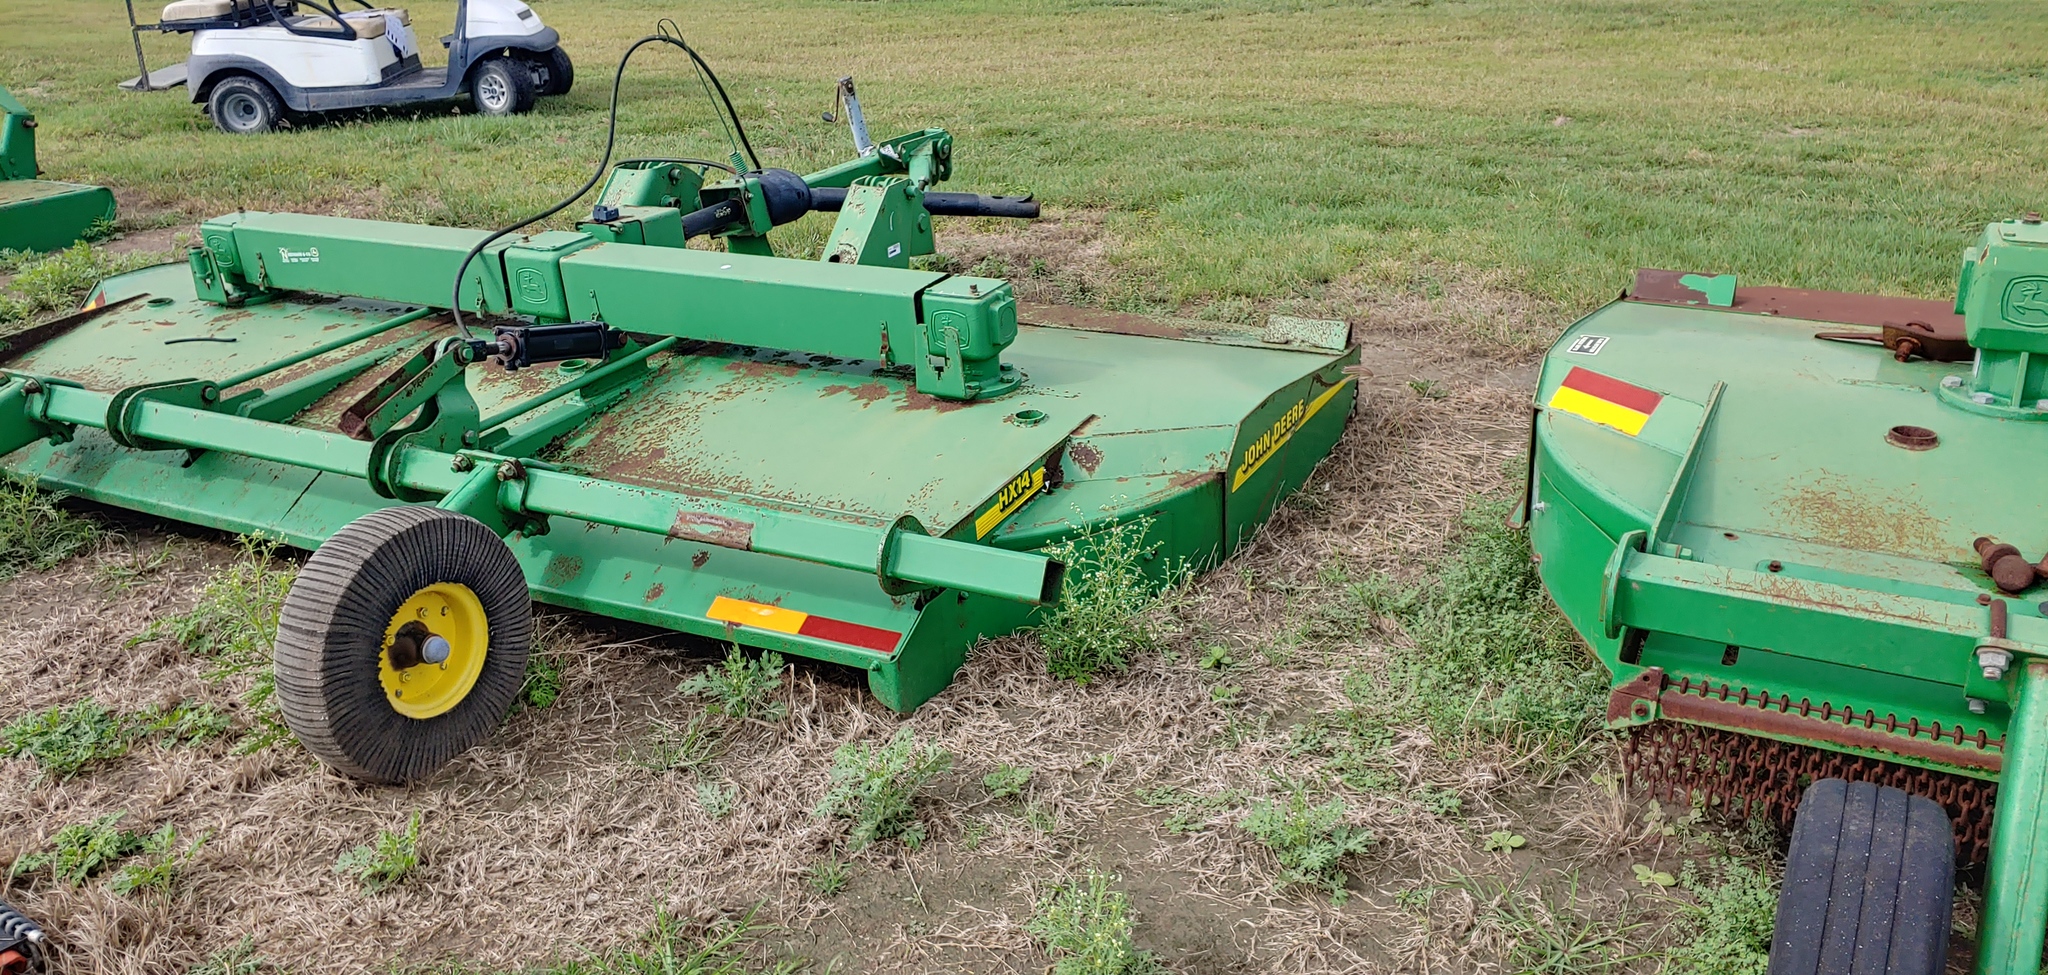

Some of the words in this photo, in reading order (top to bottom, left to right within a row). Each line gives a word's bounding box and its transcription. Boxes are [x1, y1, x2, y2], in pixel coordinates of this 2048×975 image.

[1242, 430, 1271, 472] JOHN
[1273, 399, 1305, 442] DEERE
[998, 469, 1031, 511] HX14
